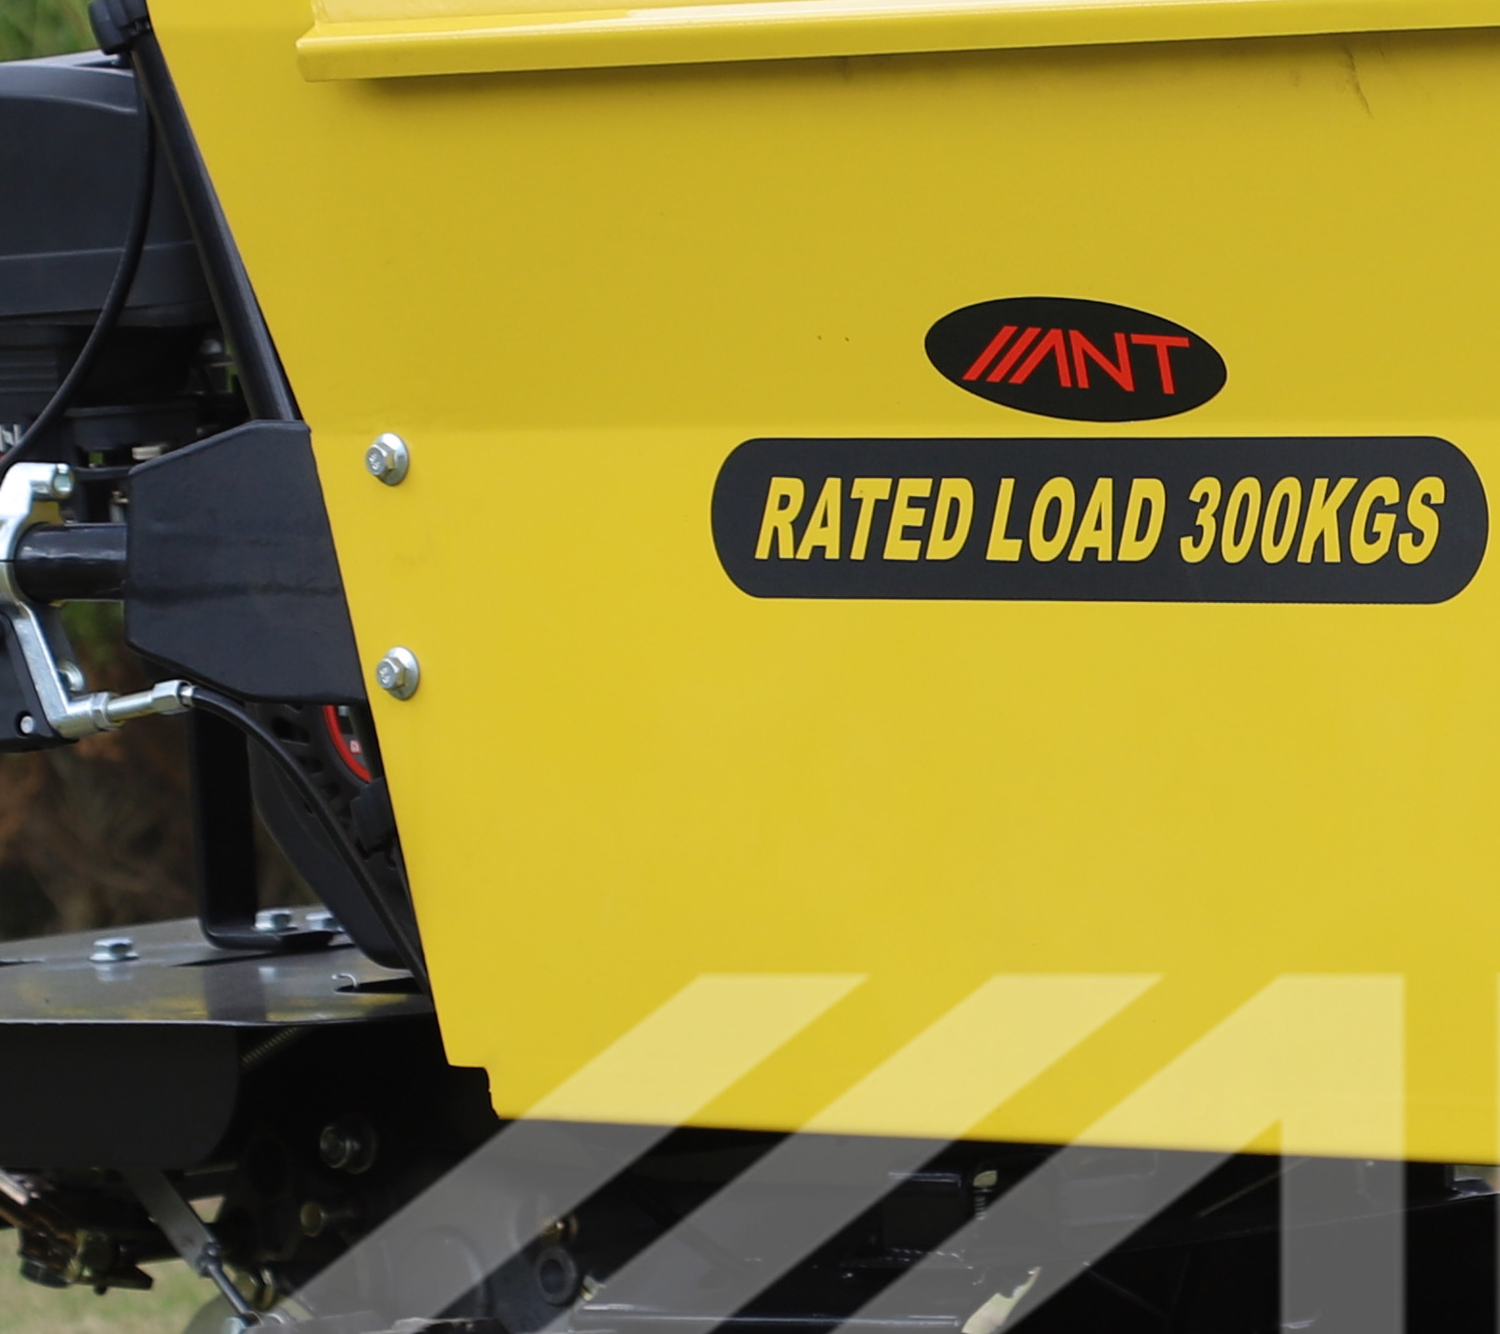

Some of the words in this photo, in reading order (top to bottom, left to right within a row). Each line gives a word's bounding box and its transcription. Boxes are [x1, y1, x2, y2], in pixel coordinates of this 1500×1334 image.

[754, 476, 974, 561] RATED
[985, 476, 1166, 563] LOAD
[1180, 476, 1446, 564] 300KGS
